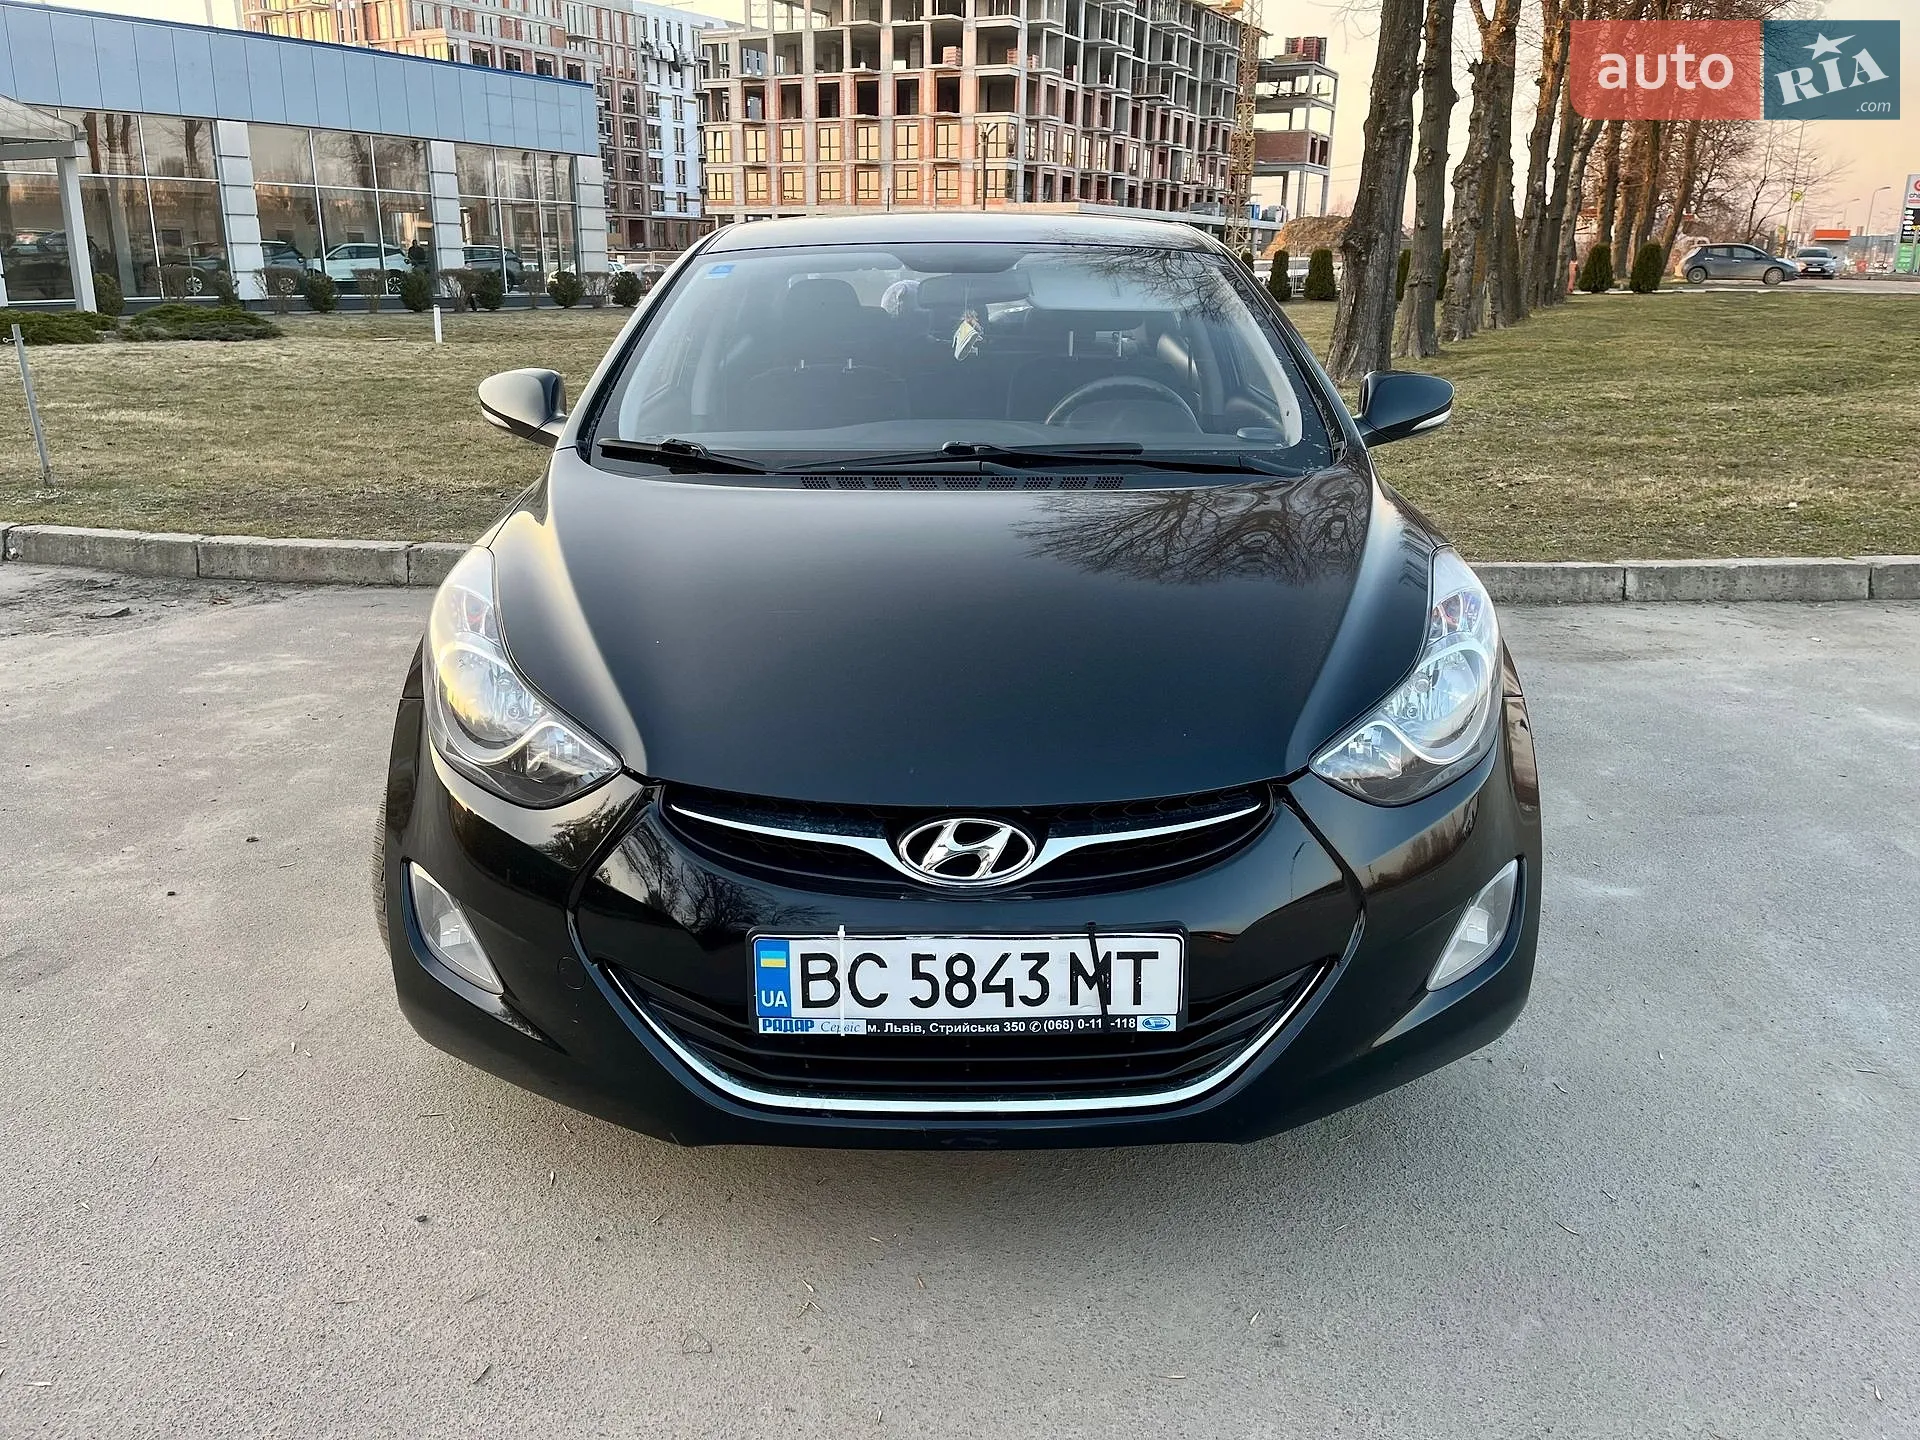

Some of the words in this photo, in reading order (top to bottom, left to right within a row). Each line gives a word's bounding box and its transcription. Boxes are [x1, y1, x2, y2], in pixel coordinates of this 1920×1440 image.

[800, 951, 889, 1009] BC
[909, 952, 1050, 1009] 5843
[1069, 950, 1159, 1007] MT
[761, 990, 788, 1008] UA
[762, 1018, 815, 1033] РАДАР
[884, 1021, 926, 1035] Львів,
[929, 1020, 1000, 1036] Стрийська
[1003, 1021, 1026, 1032] 350
[1043, 1018, 1074, 1032] (068)
